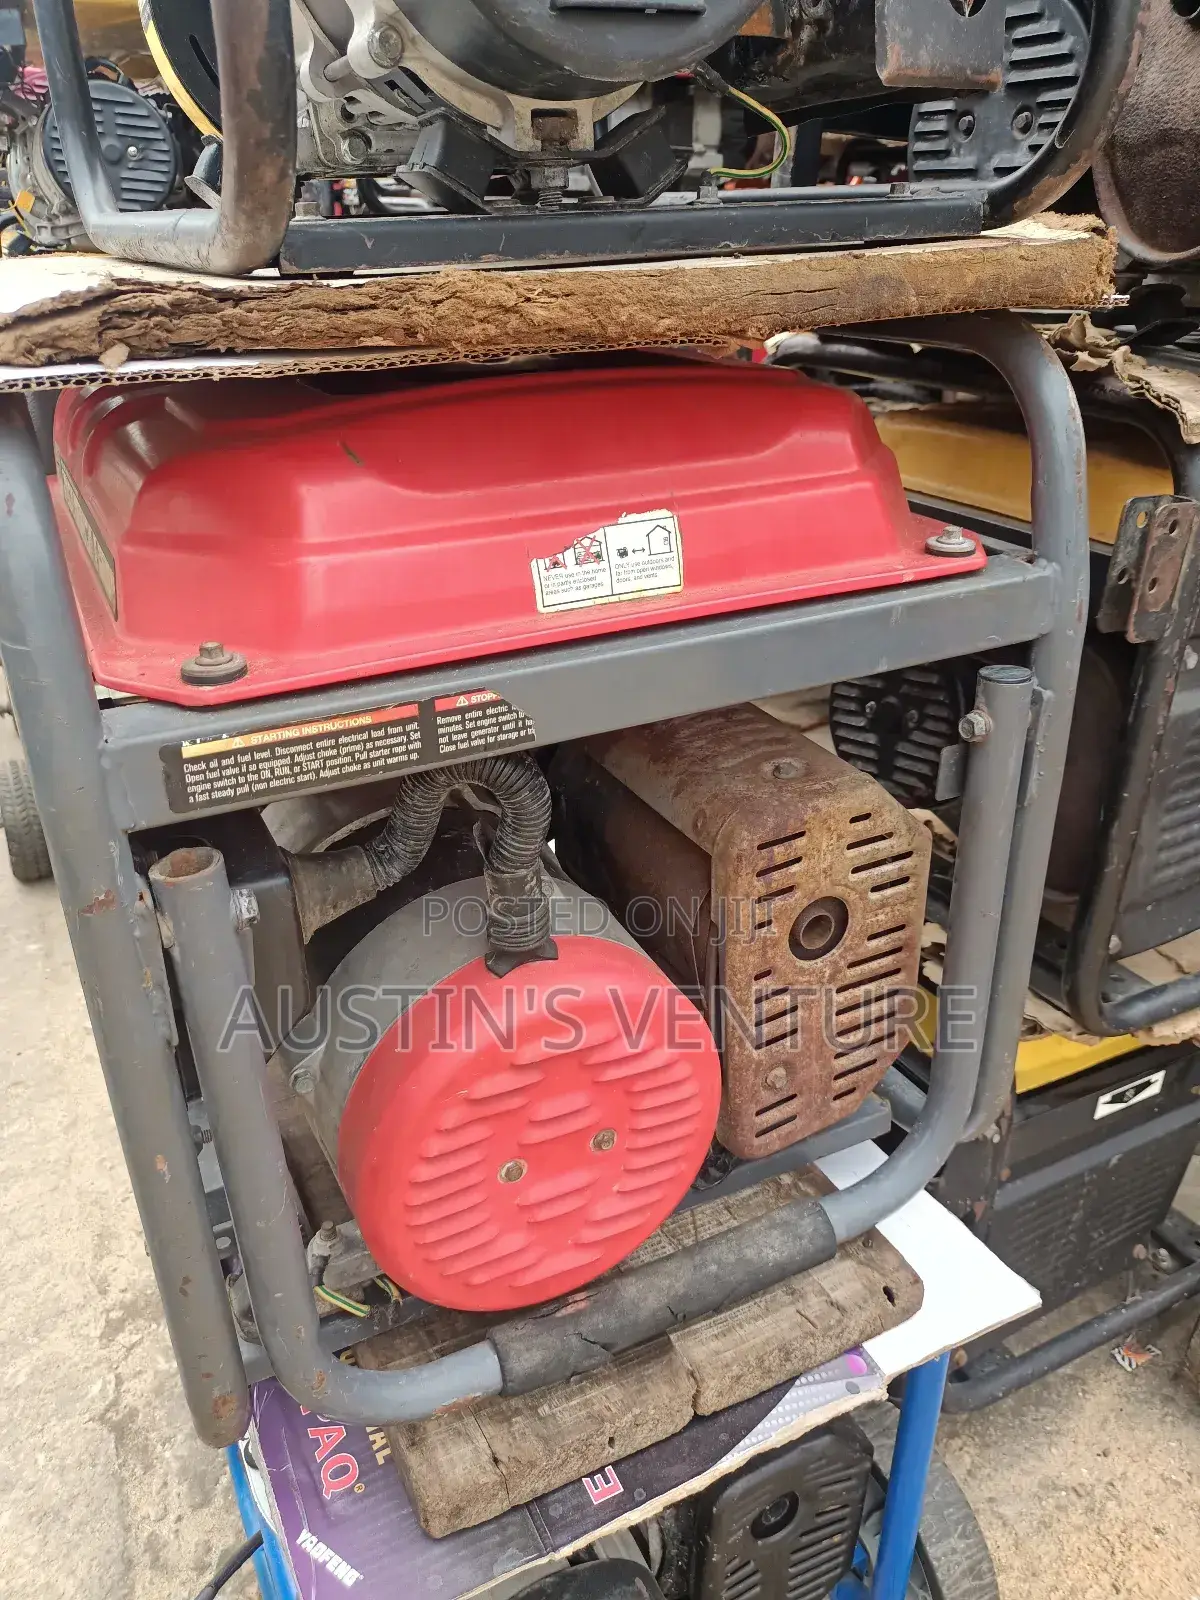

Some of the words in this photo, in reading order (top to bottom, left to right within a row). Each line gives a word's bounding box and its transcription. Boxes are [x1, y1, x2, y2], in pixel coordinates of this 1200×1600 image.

[615, 562, 630, 570] ONLY
[642, 558, 664, 566] outdoors
[543, 573, 564, 582] NEVER
[561, 586, 574, 594] such
[437, 714, 461, 725] Remove
[465, 710, 482, 720] entire
[486, 704, 508, 715] electric
[438, 724, 464, 735] minutes.
[466, 721, 476, 729] Set
[476, 716, 496, 727] engine
[498, 712, 518, 722] switch
[250, 728, 300, 744] STARTING
[302, 715, 372, 735] INSTRUCTIONS
[452, 732, 468, 741] leave
[471, 726, 499, 739] generator
[503, 722, 516, 730] until
[518, 720, 523, 728] it
[183, 761, 206, 773] Check
[209, 759, 218, 768] oil
[221, 756, 234, 766] and
[237, 752, 251, 764] fuel
[254, 749, 272, 760] level.
[275, 742, 313, 756] Disconnect
[316, 738, 336, 749] entire
[339, 731, 368, 745] electrical
[371, 728, 385, 738] load
[387, 725, 403, 736] from
[406, 722, 420, 731] unit.
[439, 743, 457, 753] Close
[458, 740, 469, 749] fuel
[471, 737, 485, 746] valve
[487, 735, 496, 743] for
[497, 730, 518, 742] storage
[185, 772, 204, 783] Open
[206, 769, 220, 781] fuel
[222, 766, 240, 777] valve
[242, 764, 247, 772] if
[258, 756, 293, 770] equipped.
[294, 752, 315, 764] Adjust
[317, 748, 337, 759] choke
[340, 742, 364, 755] (prime)
[375, 735, 409, 747] necessary.
[410, 731, 421, 740] Set
[187, 782, 211, 793] engine
[213, 777, 236, 789] switch
[238, 775, 245, 783] to
[247, 773, 258, 781] the
[260, 770, 273, 780] ON,
[274, 766, 292, 777] RUN,
[303, 760, 324, 772] START
[326, 755, 353, 769] position.
[355, 751, 368, 760] Pull
[369, 748, 390, 759] starter
[392, 744, 406, 754] rope
[407, 741, 422, 751] with
[195, 792, 210, 803] fast
[211, 788, 234, 799] steady
[236, 784, 250, 795] pull
[251, 782, 268, 792] (non
[269, 776, 296, 788] electric
[296, 770, 318, 782] start).
[320, 767, 340, 779] Adjust
[342, 762, 361, 773] choke
[372, 758, 385, 767] unit
[386, 754, 408, 765] warms
[410, 752, 420, 760] up.
